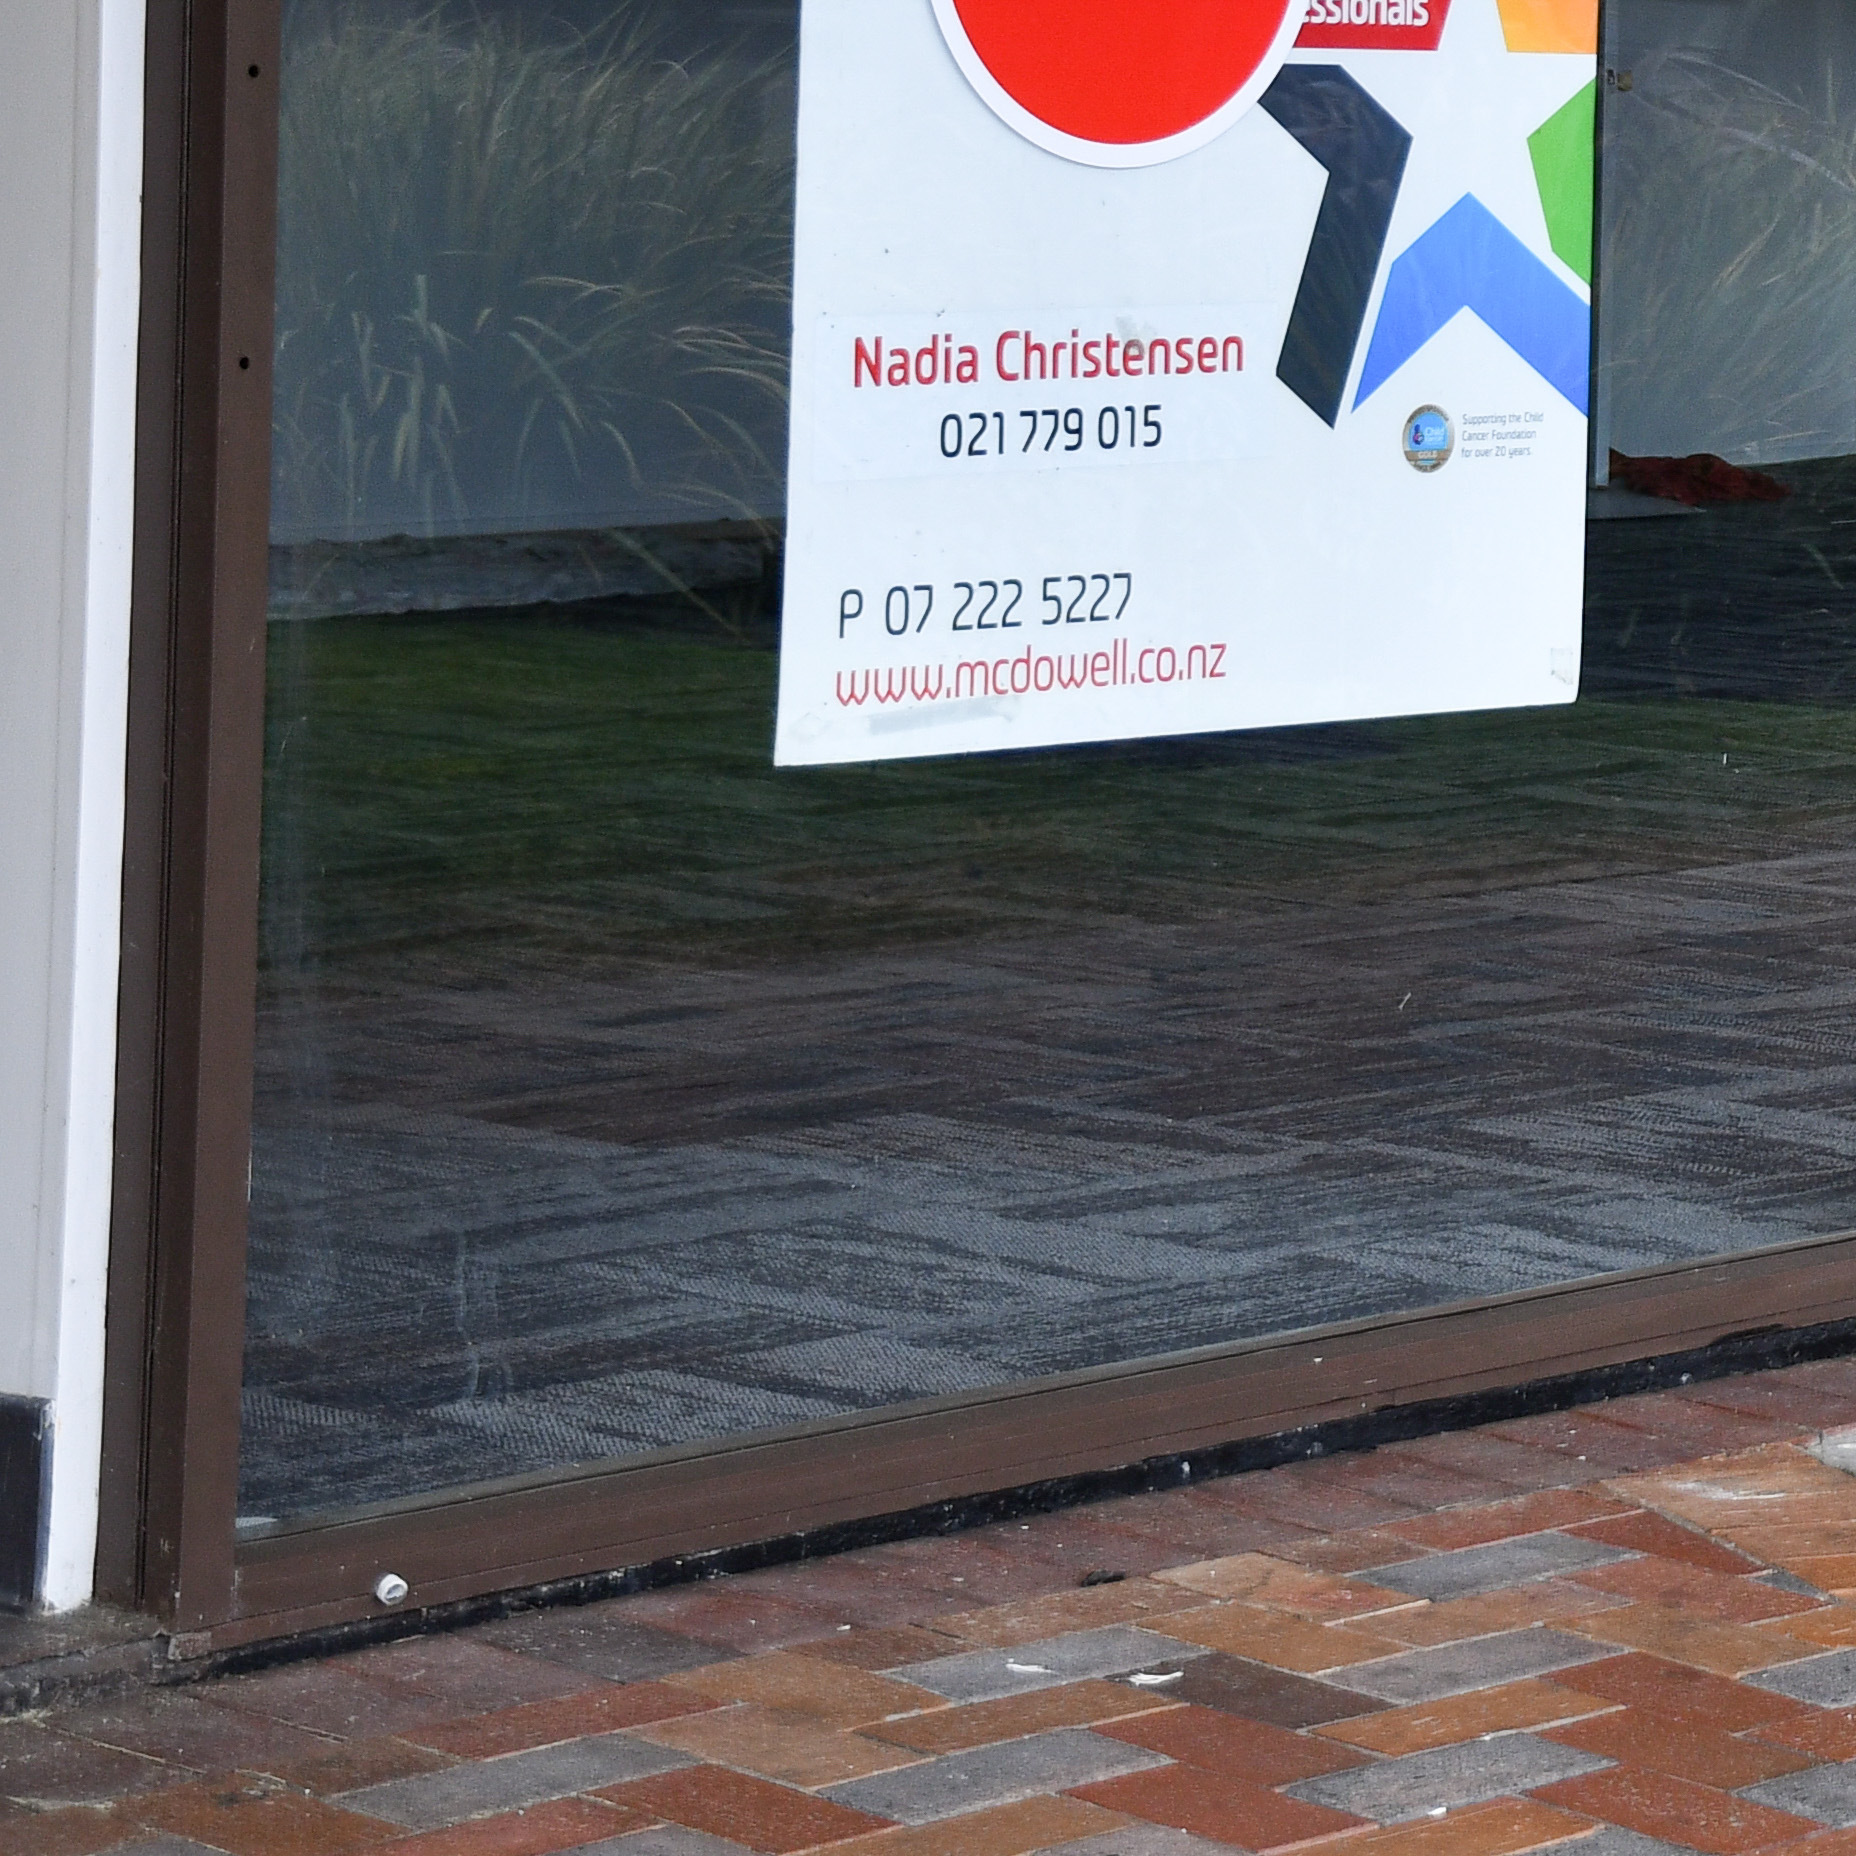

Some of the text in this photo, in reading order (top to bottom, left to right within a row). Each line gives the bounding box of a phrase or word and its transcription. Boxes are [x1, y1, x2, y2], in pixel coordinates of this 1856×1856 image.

[853, 327, 1245, 389] Nadia Christensen
[940, 404, 1163, 459] 021 779 015
[1462, 413, 1507, 427] Supporting
[1508, 413, 1522, 423] the
[1524, 411, 1543, 423] Child
[1462, 429, 1537, 442] Cancer Foundation
[1461, 446, 1473, 458] for
[1474, 447, 1493, 458] over
[1494, 446, 1506, 457] 20
[838, 572, 1133, 640] P 07 222 5227
[834, 637, 1228, 707] www.mcdowell.co.nz
